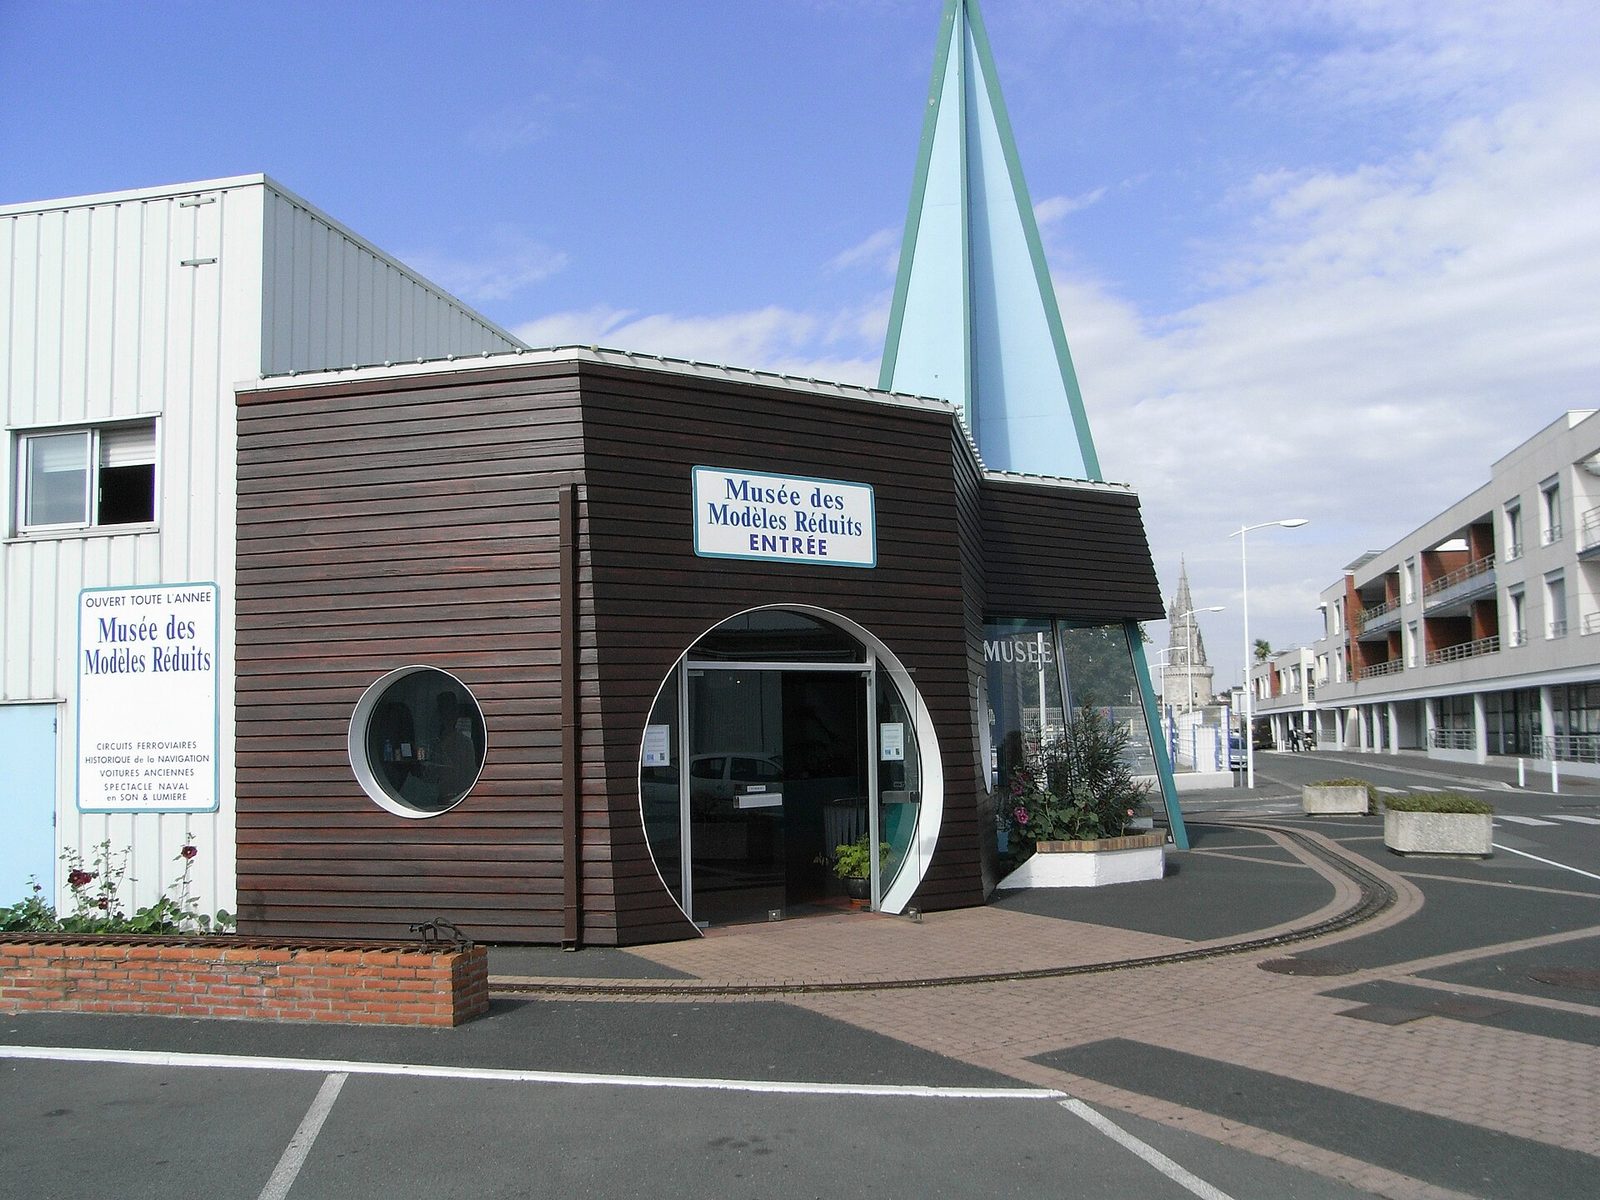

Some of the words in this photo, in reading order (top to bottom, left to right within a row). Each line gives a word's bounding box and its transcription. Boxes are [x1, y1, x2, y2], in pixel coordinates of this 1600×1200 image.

[725, 478, 800, 505] Musée
[811, 488, 844, 510] des
[707, 502, 787, 530] Modèles
[794, 511, 862, 536] Réduits
[750, 534, 827, 555] ENTRÉE
[86, 596, 126, 608] OUVERT
[131, 594, 162, 605] TOUTE
[98, 615, 157, 643] Musée
[166, 614, 195, 640] des
[984, 640, 1053, 662] MUSEE
[84, 648, 146, 675] Modèles
[152, 645, 211, 672] Réduits
[97, 742, 133, 750] CIRCUITS
[137, 741, 197, 750] FERROVIAIRES
[85, 756, 131, 764] HISTORIQUE
[100, 769, 139, 777] VOITURES
[104, 783, 152, 791] SPECTACLE
[120, 793, 138, 801] SON
[142, 793, 148, 801] &
